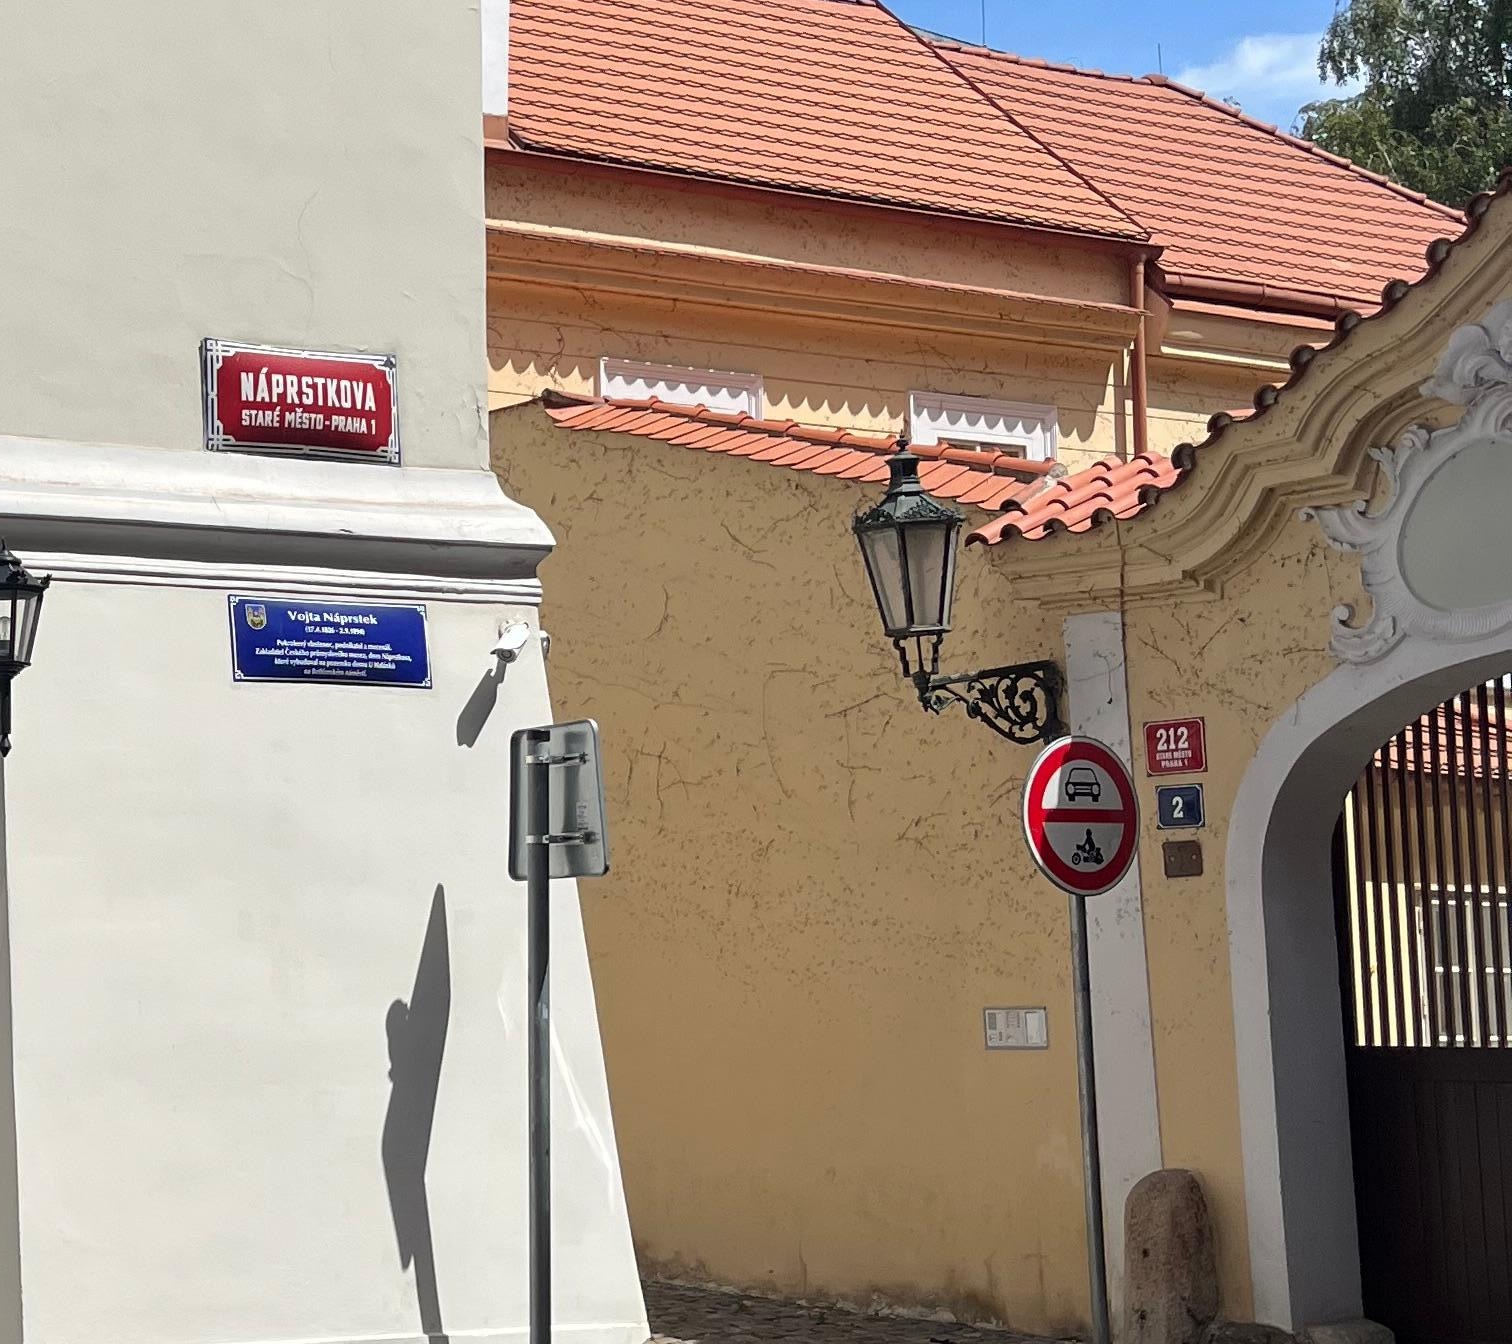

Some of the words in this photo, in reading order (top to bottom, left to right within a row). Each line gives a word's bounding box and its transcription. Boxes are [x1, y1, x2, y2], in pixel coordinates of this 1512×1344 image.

[240, 366, 376, 412] NÁPRSTKOVA
[241, 406, 280, 427] STARÉ
[371, 419, 376, 435] 1
[287, 610, 321, 624] Vojta
[323, 612, 378, 626] Náprstek
[1156, 726, 1189, 751] 212
[1172, 796, 1184, 818] 2
